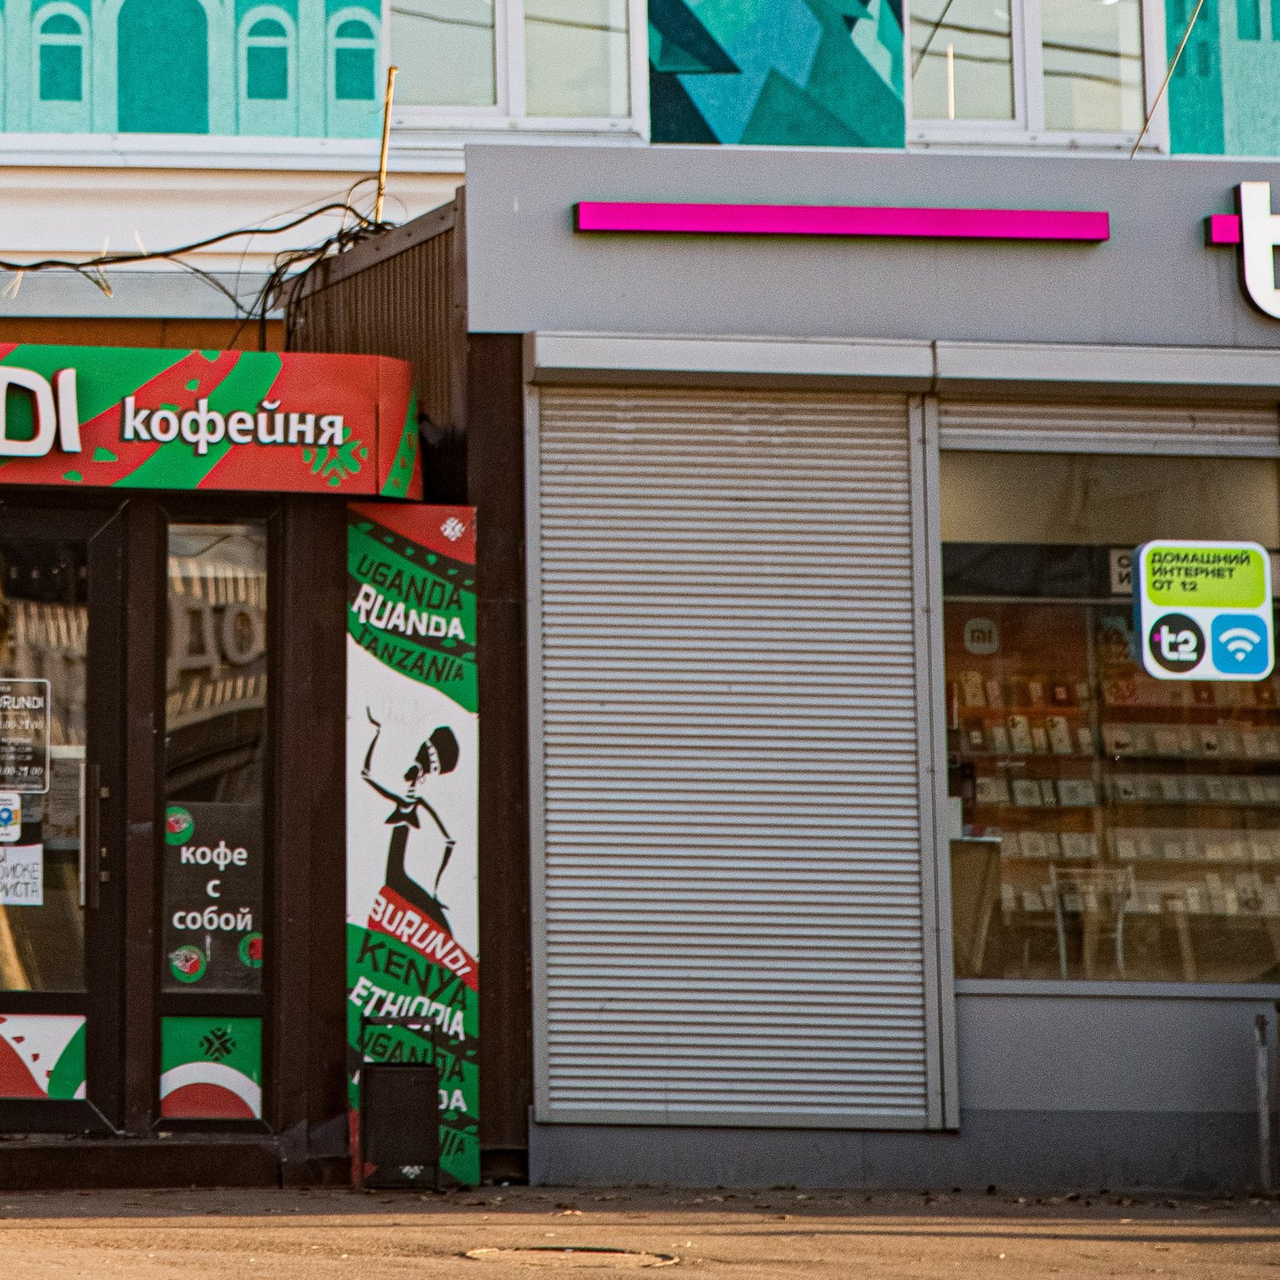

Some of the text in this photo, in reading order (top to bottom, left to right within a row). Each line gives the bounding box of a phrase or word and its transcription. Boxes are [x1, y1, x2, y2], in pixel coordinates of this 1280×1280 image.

[123, 396, 345, 455] кофейня
[1151, 550, 1251, 565] ДОМАШНИЙ
[1151, 566, 1235, 579] ИНТЕРНЕТ
[355, 554, 464, 611] UGANDA
[1152, 580, 1174, 591] ОТ
[351, 583, 466, 639] RUANDA
[356, 626, 465, 683] TANZANIA
[1154, 625, 1198, 661] t2
[180, 840, 248, 871] кофе
[206, 879, 221, 898] с
[172, 906, 253, 931] собой
[369, 893, 472, 977] BURUNDI
[355, 932, 468, 1010] KENYA
[348, 976, 466, 1041] ETHIOPIA
